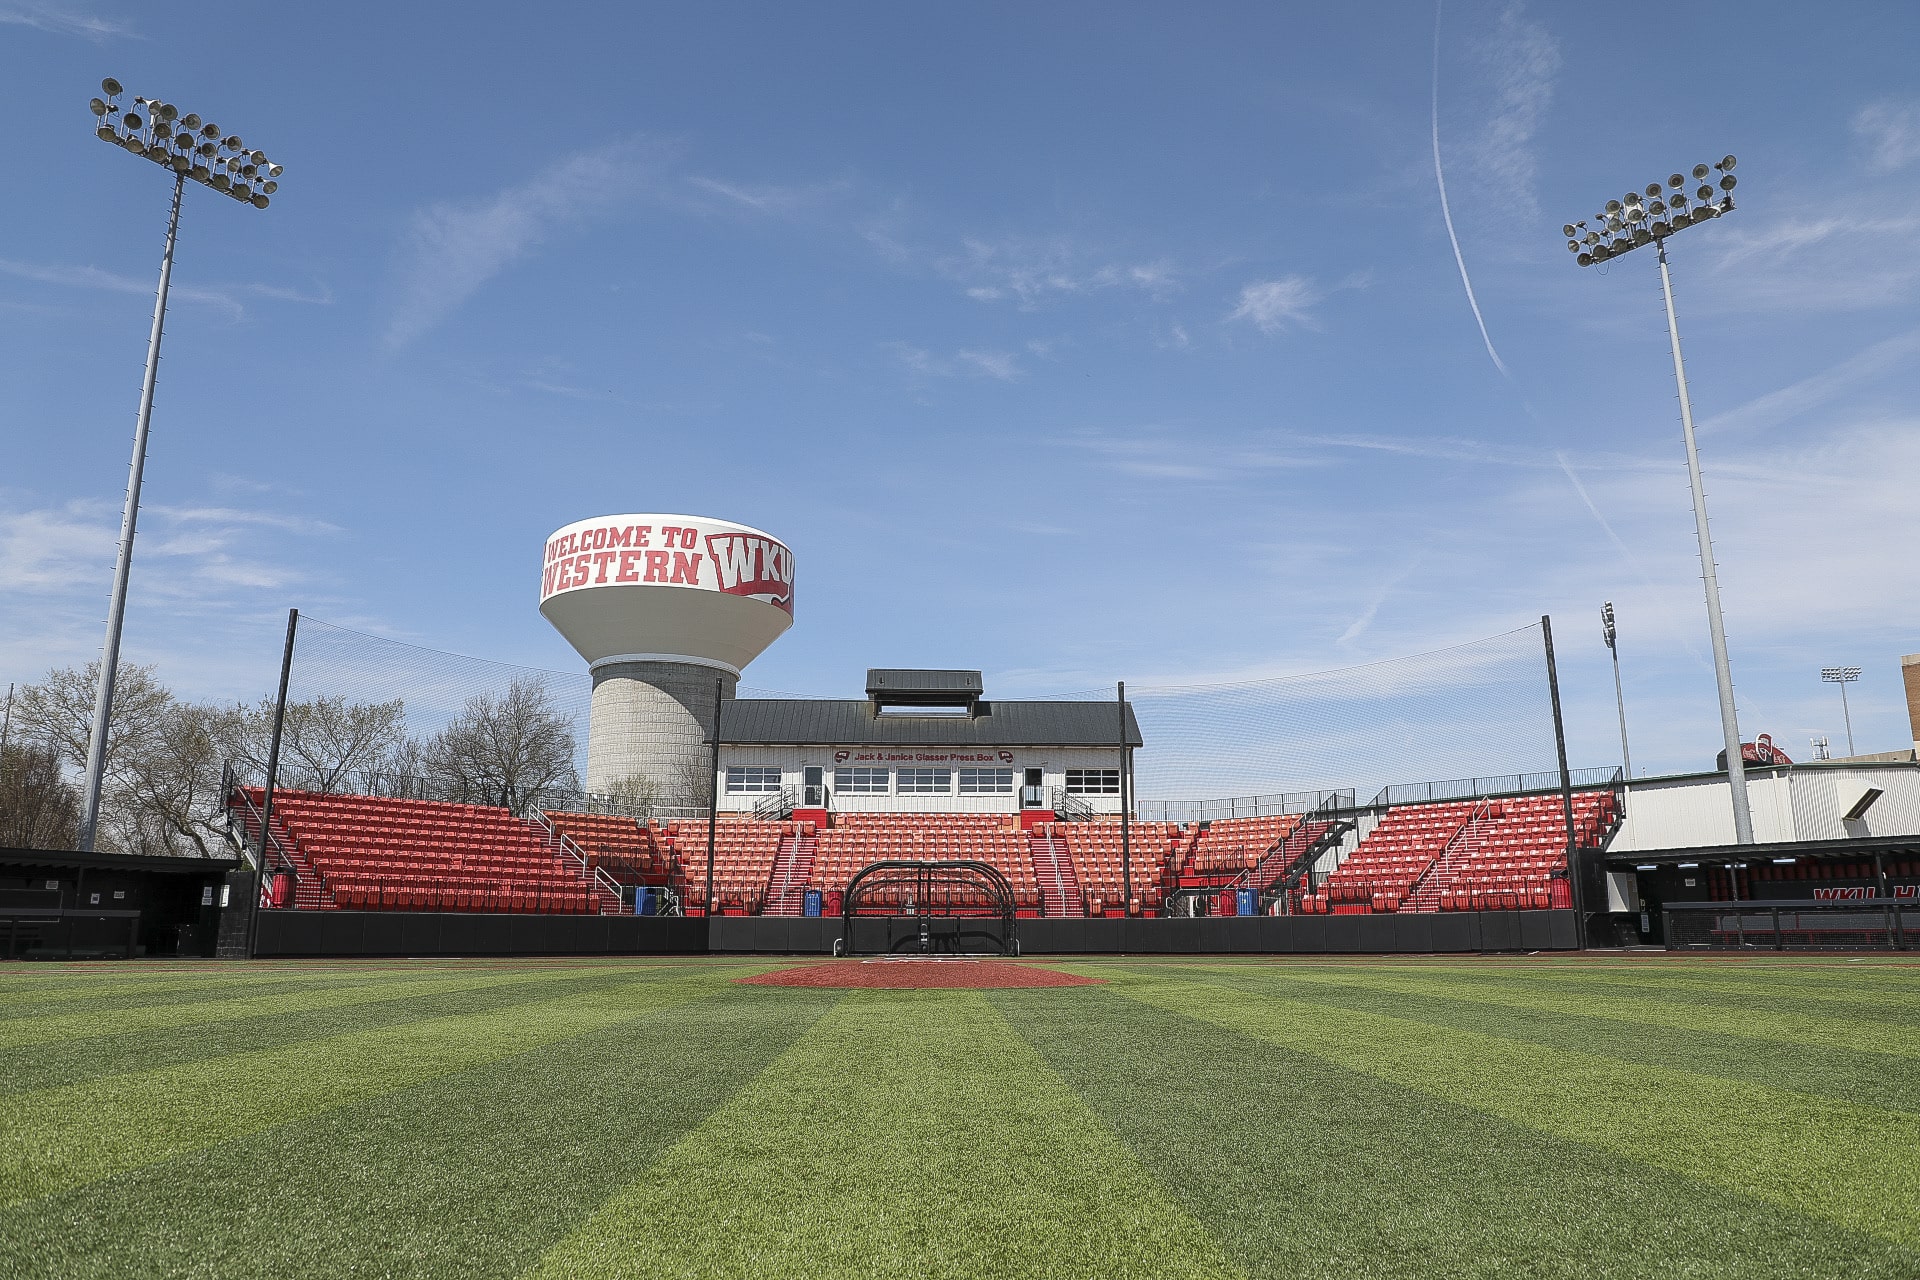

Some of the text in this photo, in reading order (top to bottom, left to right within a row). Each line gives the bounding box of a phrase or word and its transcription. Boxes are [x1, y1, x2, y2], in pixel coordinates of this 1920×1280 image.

[547, 526, 698, 563] WELCOME TO
[710, 536, 792, 588] WKU
[543, 550, 703, 598] WESTERN
[854, 752, 875, 761] Jack
[877, 753, 884, 761] &
[885, 752, 914, 761] Janice
[915, 753, 949, 762] Glasser
[950, 753, 975, 762] Press
[976, 753, 995, 762] Box
[1813, 886, 1876, 900] WKU
